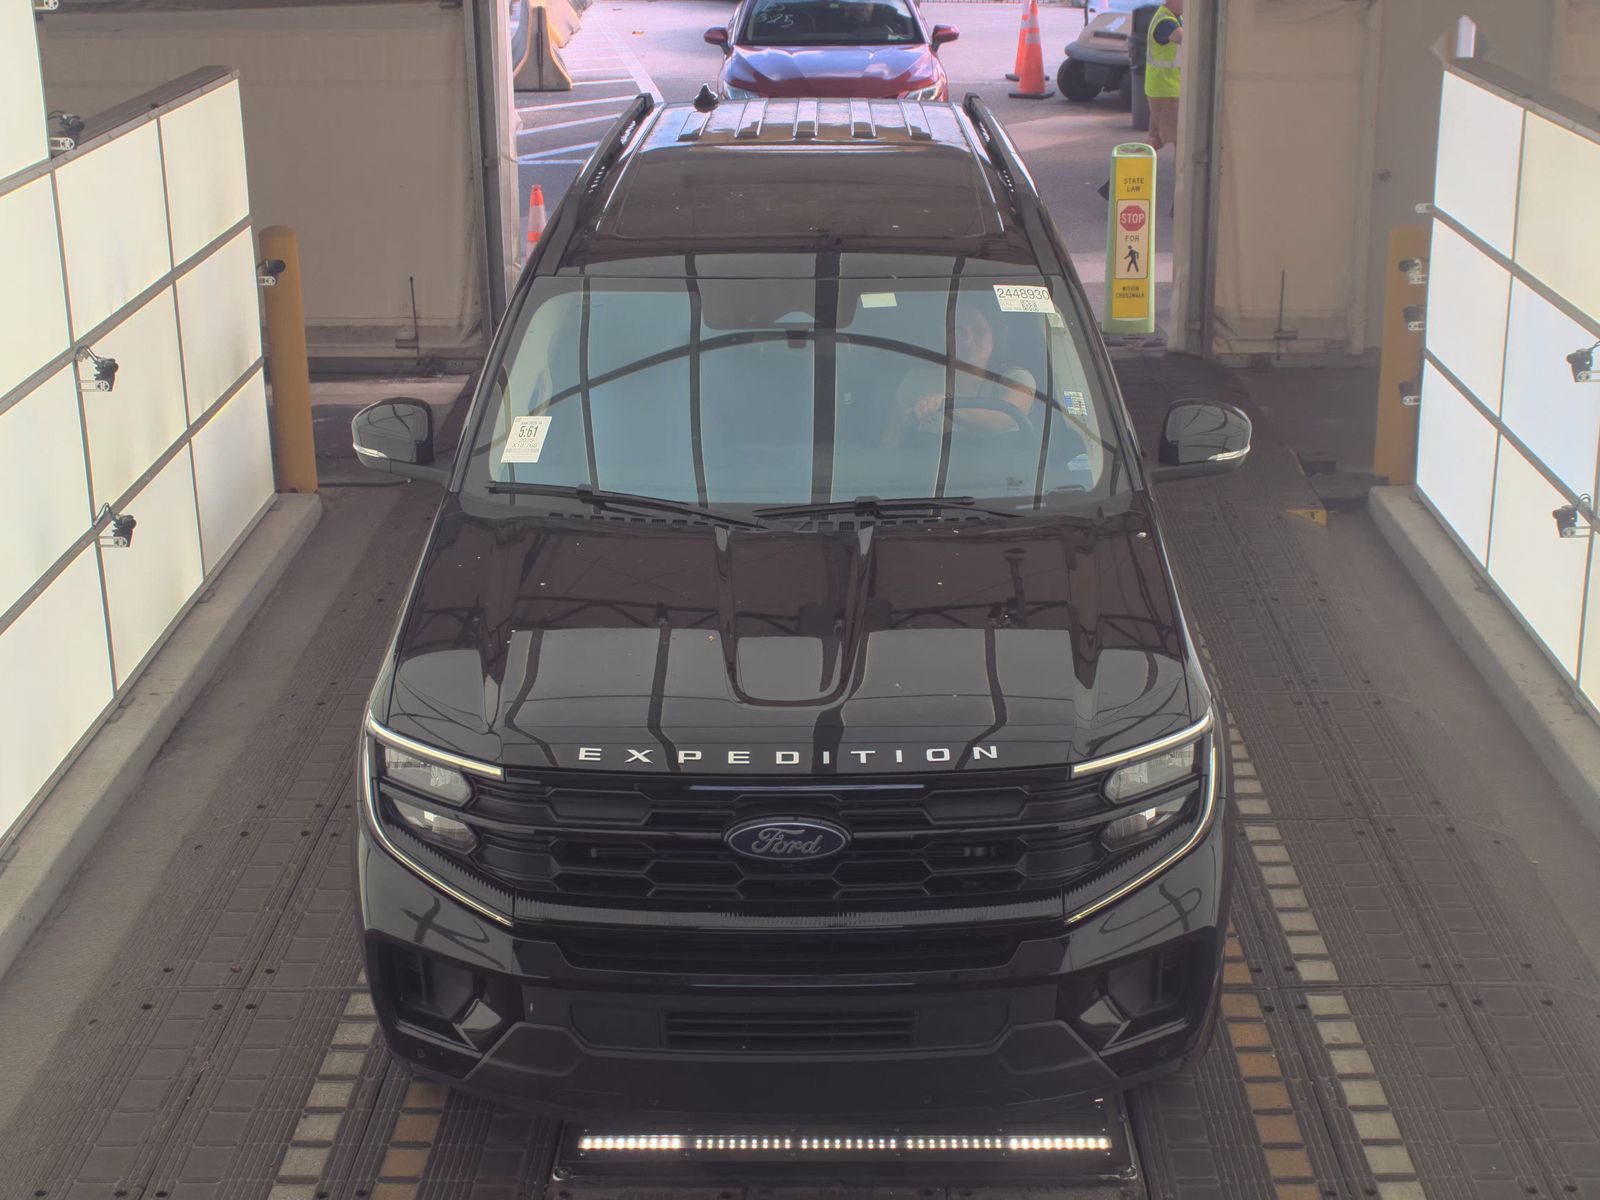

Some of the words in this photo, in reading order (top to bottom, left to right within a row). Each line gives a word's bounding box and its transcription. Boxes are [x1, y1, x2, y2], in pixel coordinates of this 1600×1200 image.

[1123, 177, 1145, 185] STATE
[1120, 213, 1145, 224] STOP
[997, 287, 1050, 300] 2448930
[518, 425, 540, 438] 5:61
[578, 744, 998, 765] EXPEDITION
[751, 827, 824, 854] Ford
